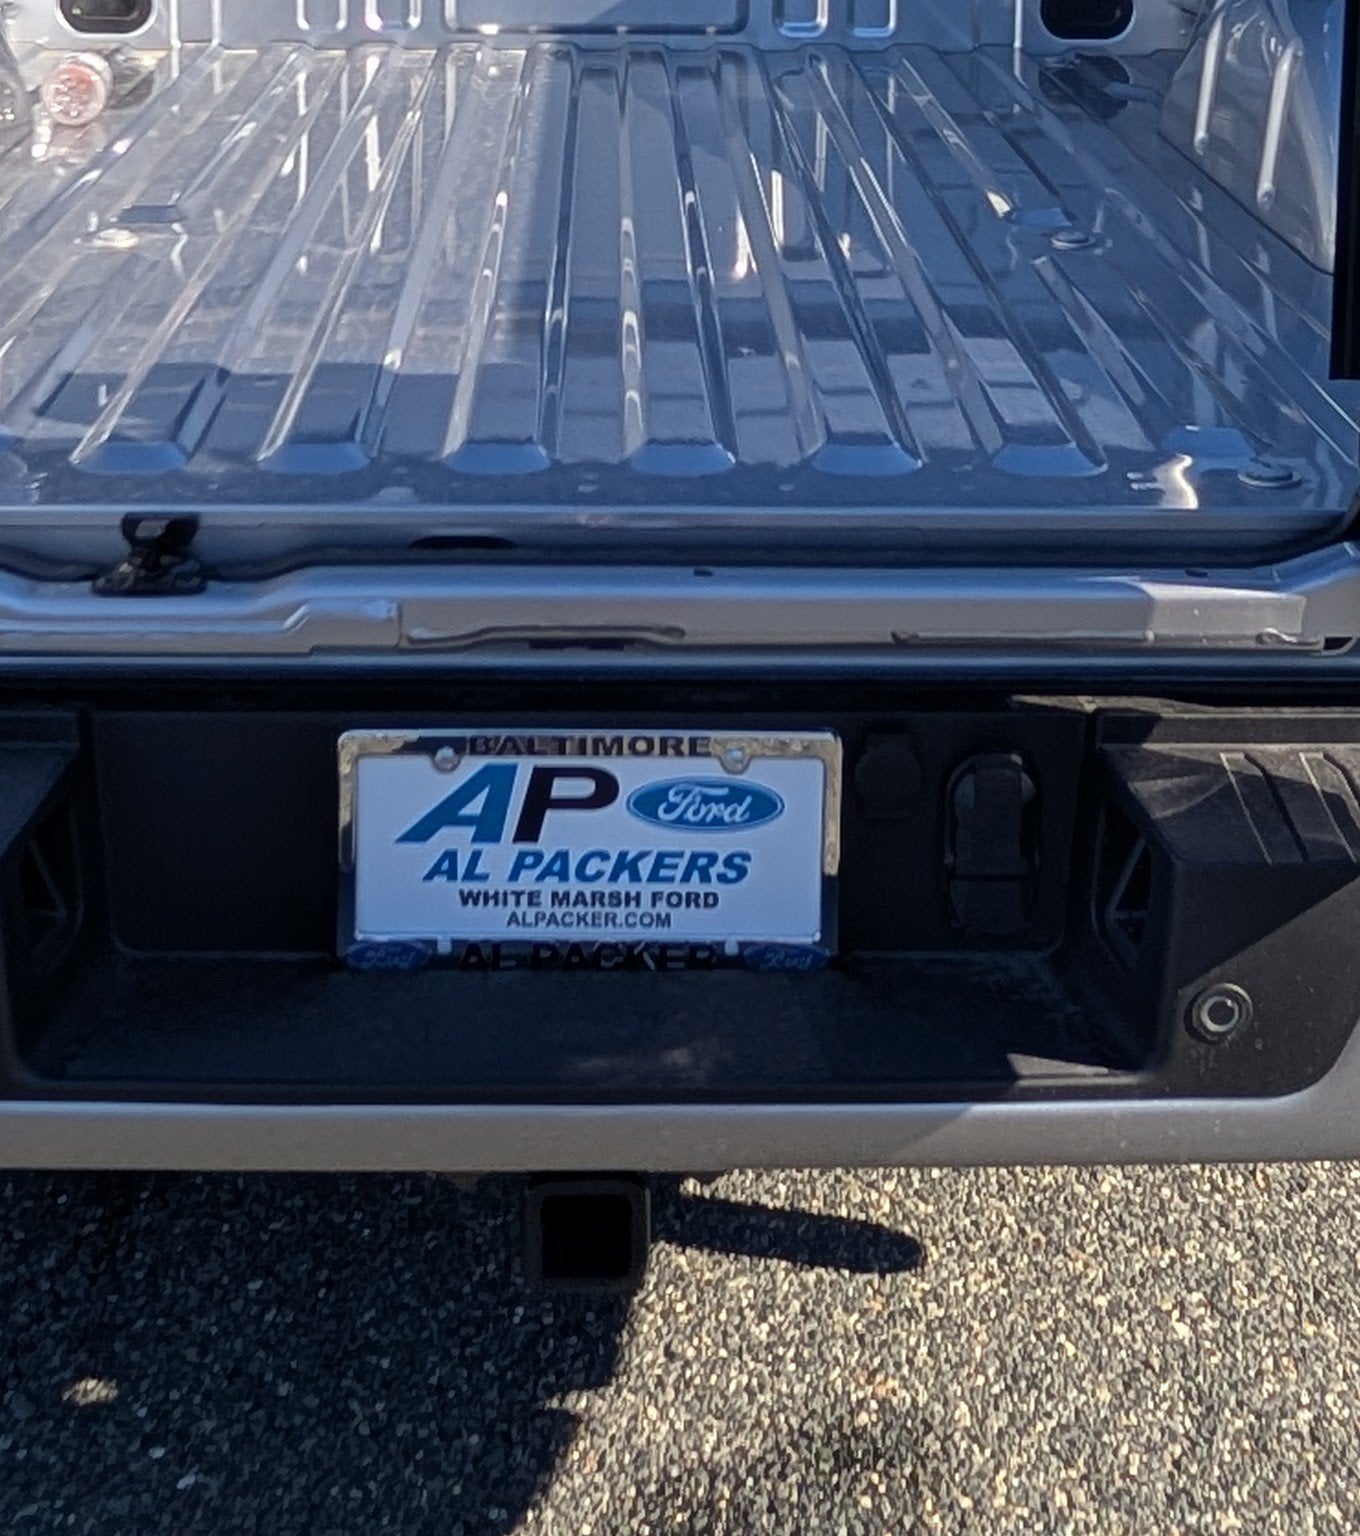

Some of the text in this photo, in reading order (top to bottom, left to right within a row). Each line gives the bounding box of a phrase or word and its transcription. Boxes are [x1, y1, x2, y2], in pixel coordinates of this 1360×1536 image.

[466, 735, 713, 757] BALTIMORE
[395, 762, 620, 844] AP
[656, 783, 753, 824] Ford
[422, 848, 752, 885] AL PACKERS
[458, 890, 720, 909] WHITE MARSH FORD
[505, 910, 672, 929] ALPACKER.COM
